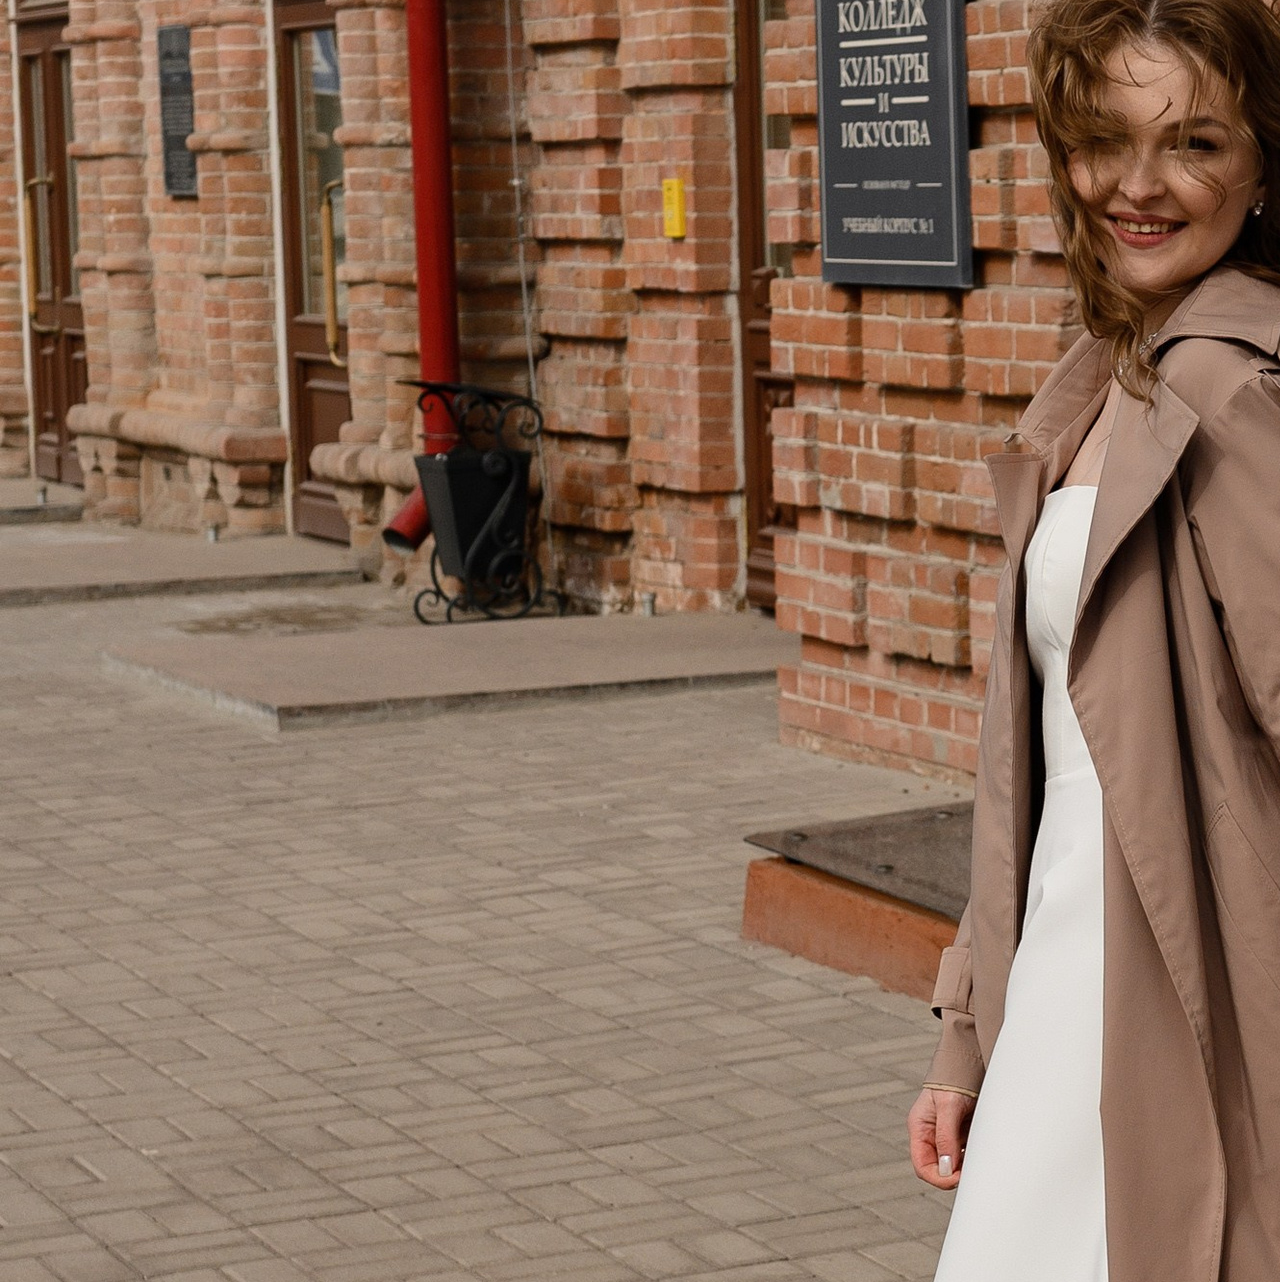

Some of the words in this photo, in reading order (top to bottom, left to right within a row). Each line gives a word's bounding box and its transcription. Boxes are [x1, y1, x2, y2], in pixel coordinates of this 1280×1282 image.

[839, 52, 930, 87] КУЛЬТУРЫ
[878, 92, 890, 114] И
[841, 119, 931, 148] ИСКУССТВА
